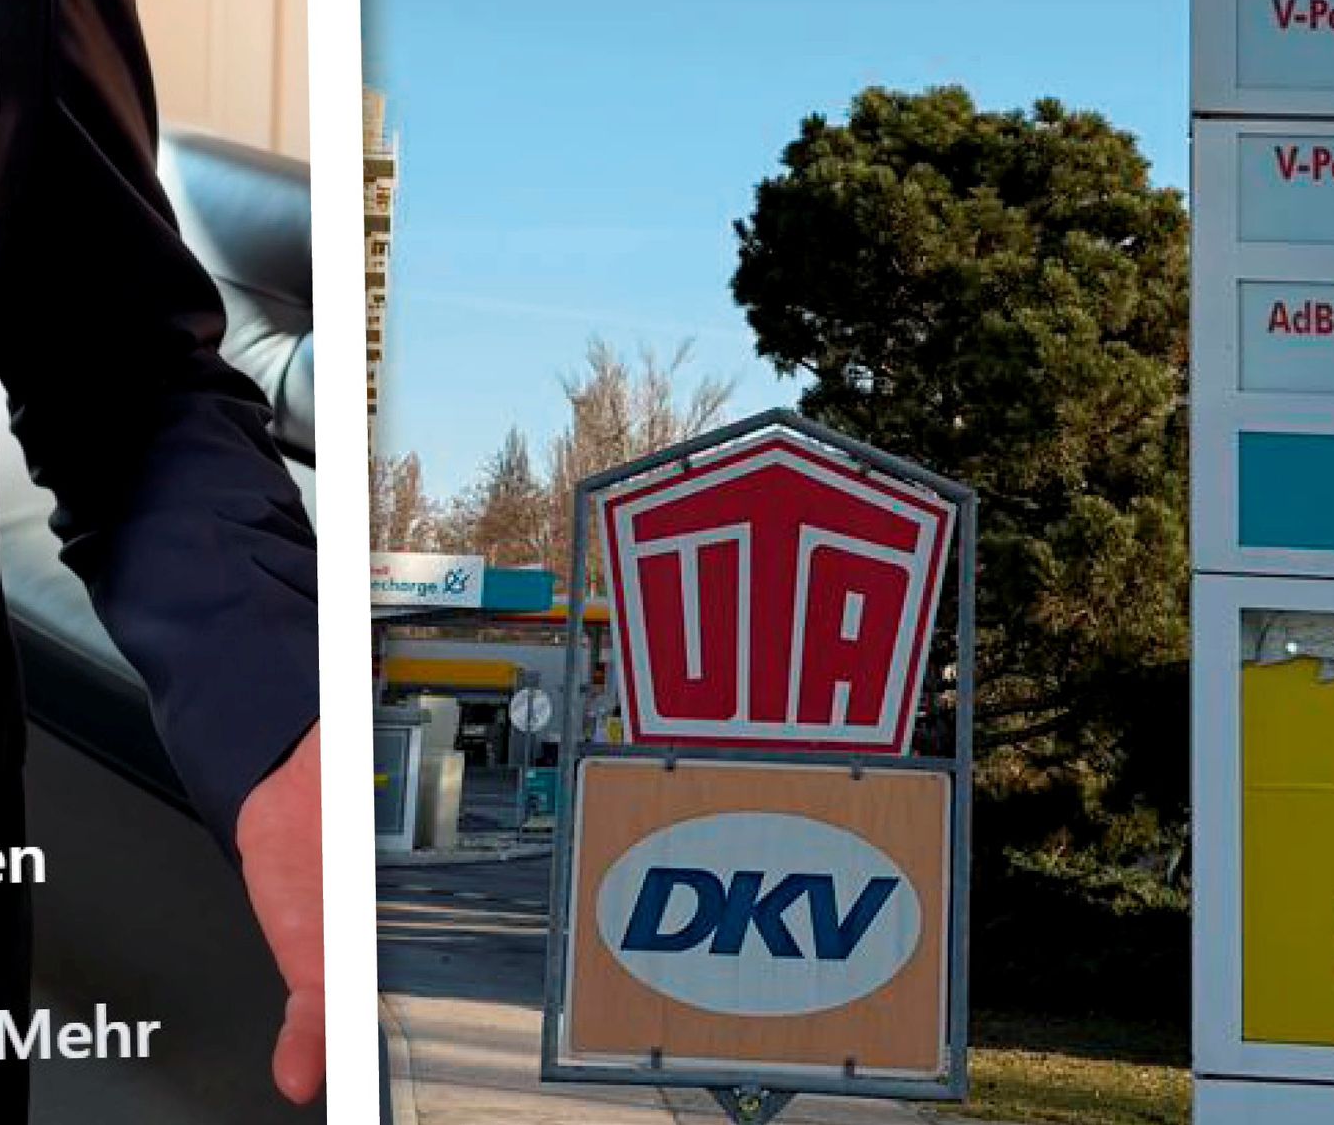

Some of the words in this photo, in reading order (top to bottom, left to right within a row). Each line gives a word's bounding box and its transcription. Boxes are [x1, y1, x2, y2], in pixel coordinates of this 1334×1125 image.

[369, 578, 438, 597] echarge
[631, 461, 921, 728] UTA
[620, 866, 901, 961] DKV
